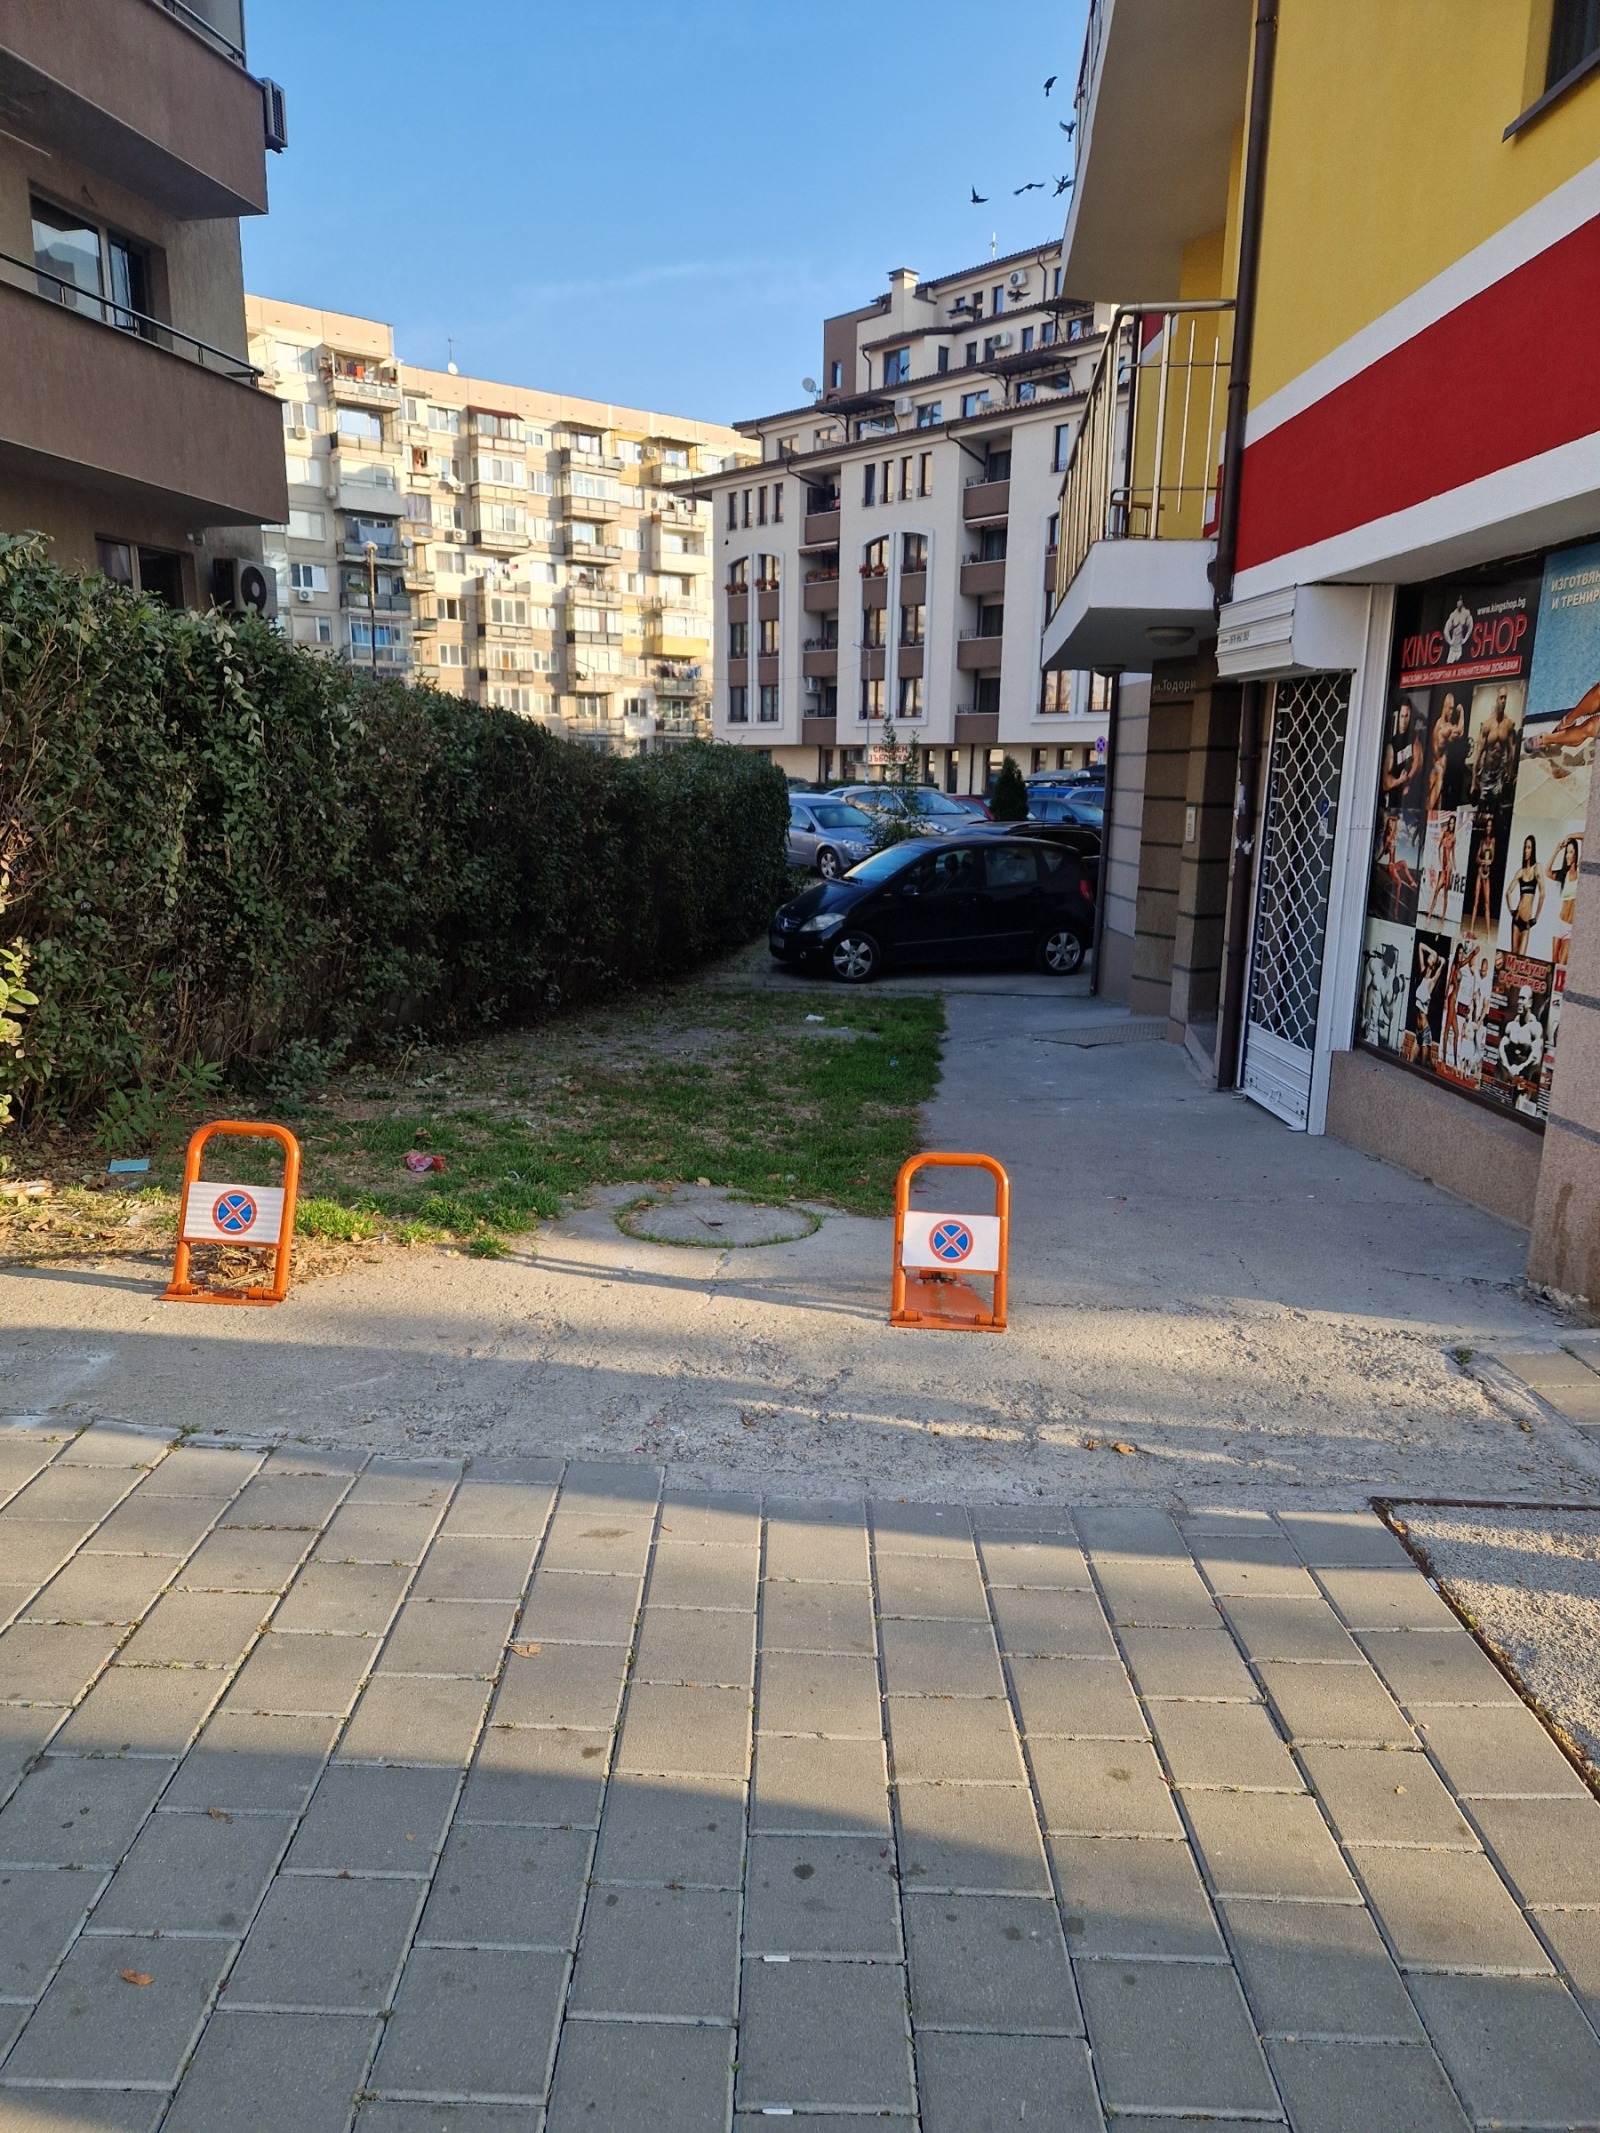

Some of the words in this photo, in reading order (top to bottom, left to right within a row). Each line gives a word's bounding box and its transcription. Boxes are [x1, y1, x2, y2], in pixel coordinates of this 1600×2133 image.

[1477, 597, 1526, 615] www.kingshop.bg
[1551, 597, 1559, 610] И
[1401, 630, 1443, 669] KING
[1470, 614, 1527, 658] SHOP
[1491, 660, 1518, 673] ДОБАВКИ
[873, 745, 908, 753] СПЕН
[1505, 954, 1547, 979] Мускули
